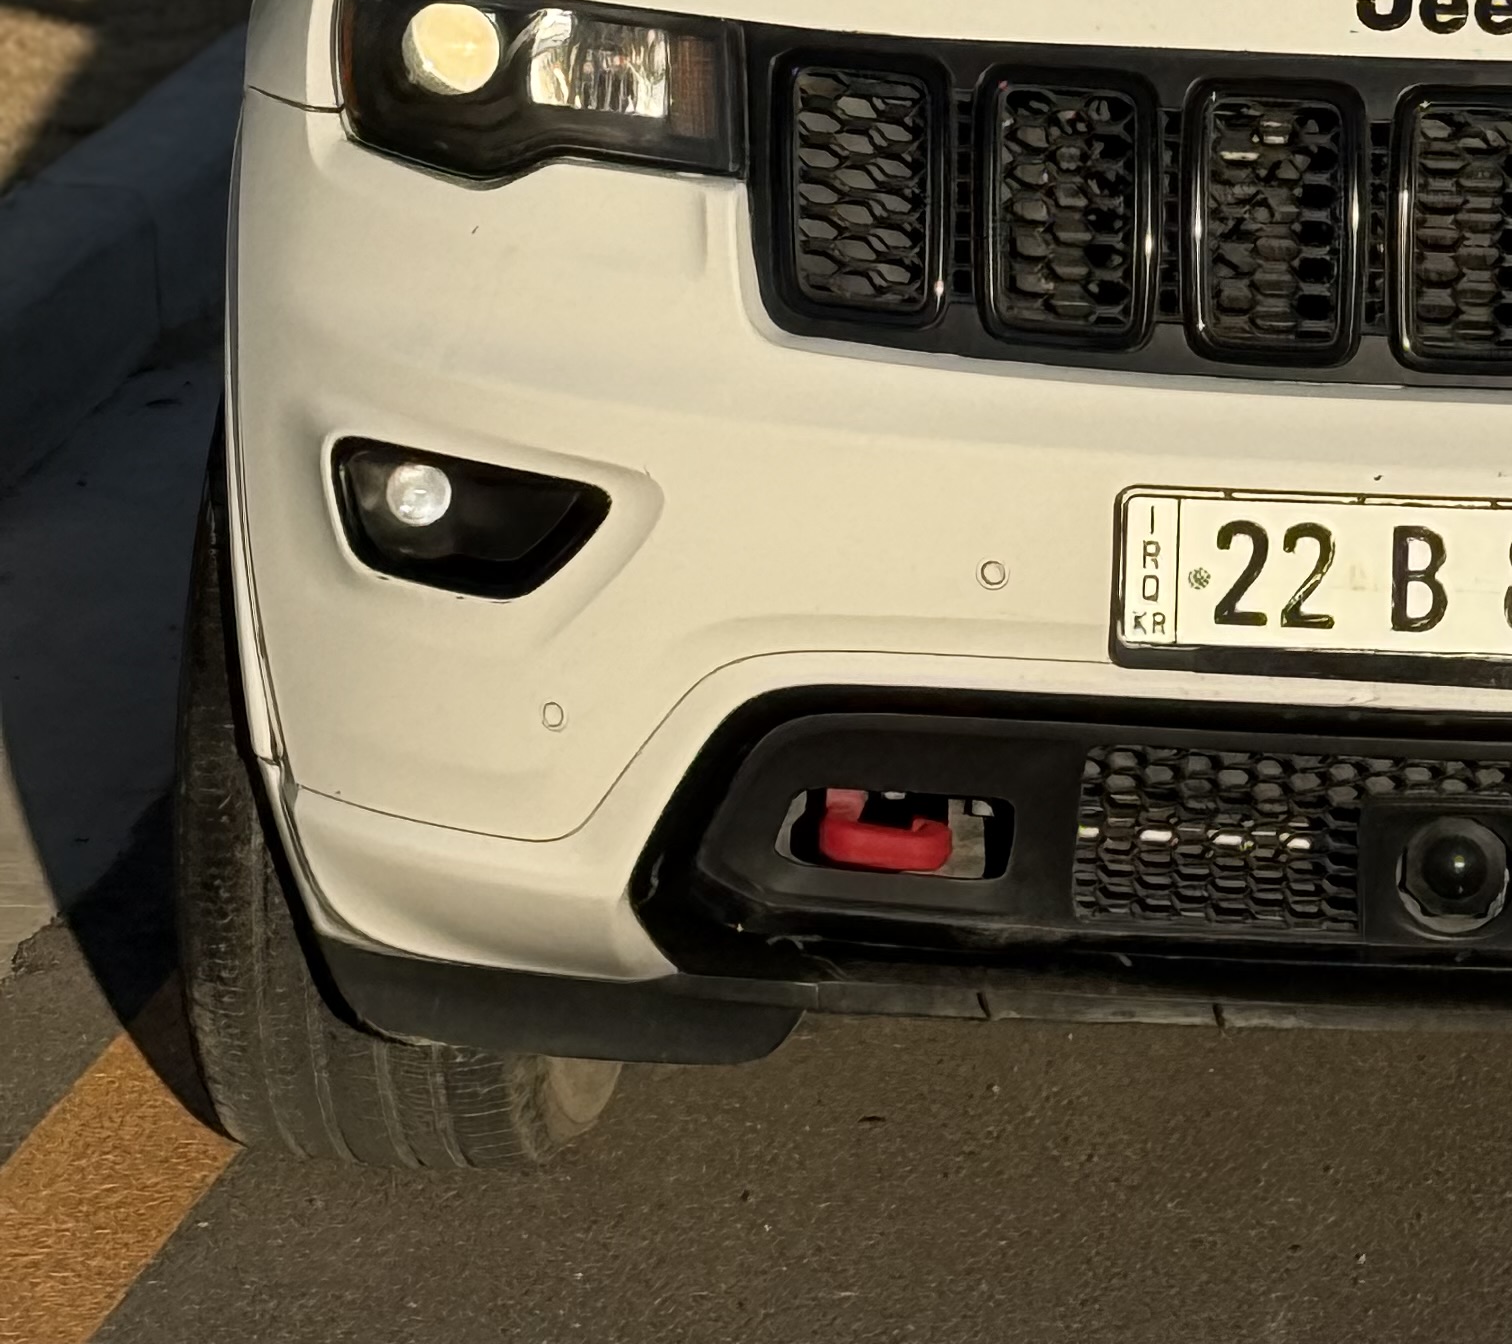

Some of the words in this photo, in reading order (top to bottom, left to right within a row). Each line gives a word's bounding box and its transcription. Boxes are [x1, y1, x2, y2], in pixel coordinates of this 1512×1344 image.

[1214, 519, 1336, 630] 22
[1391, 525, 1448, 632] B
[1132, 611, 1167, 635] KR
